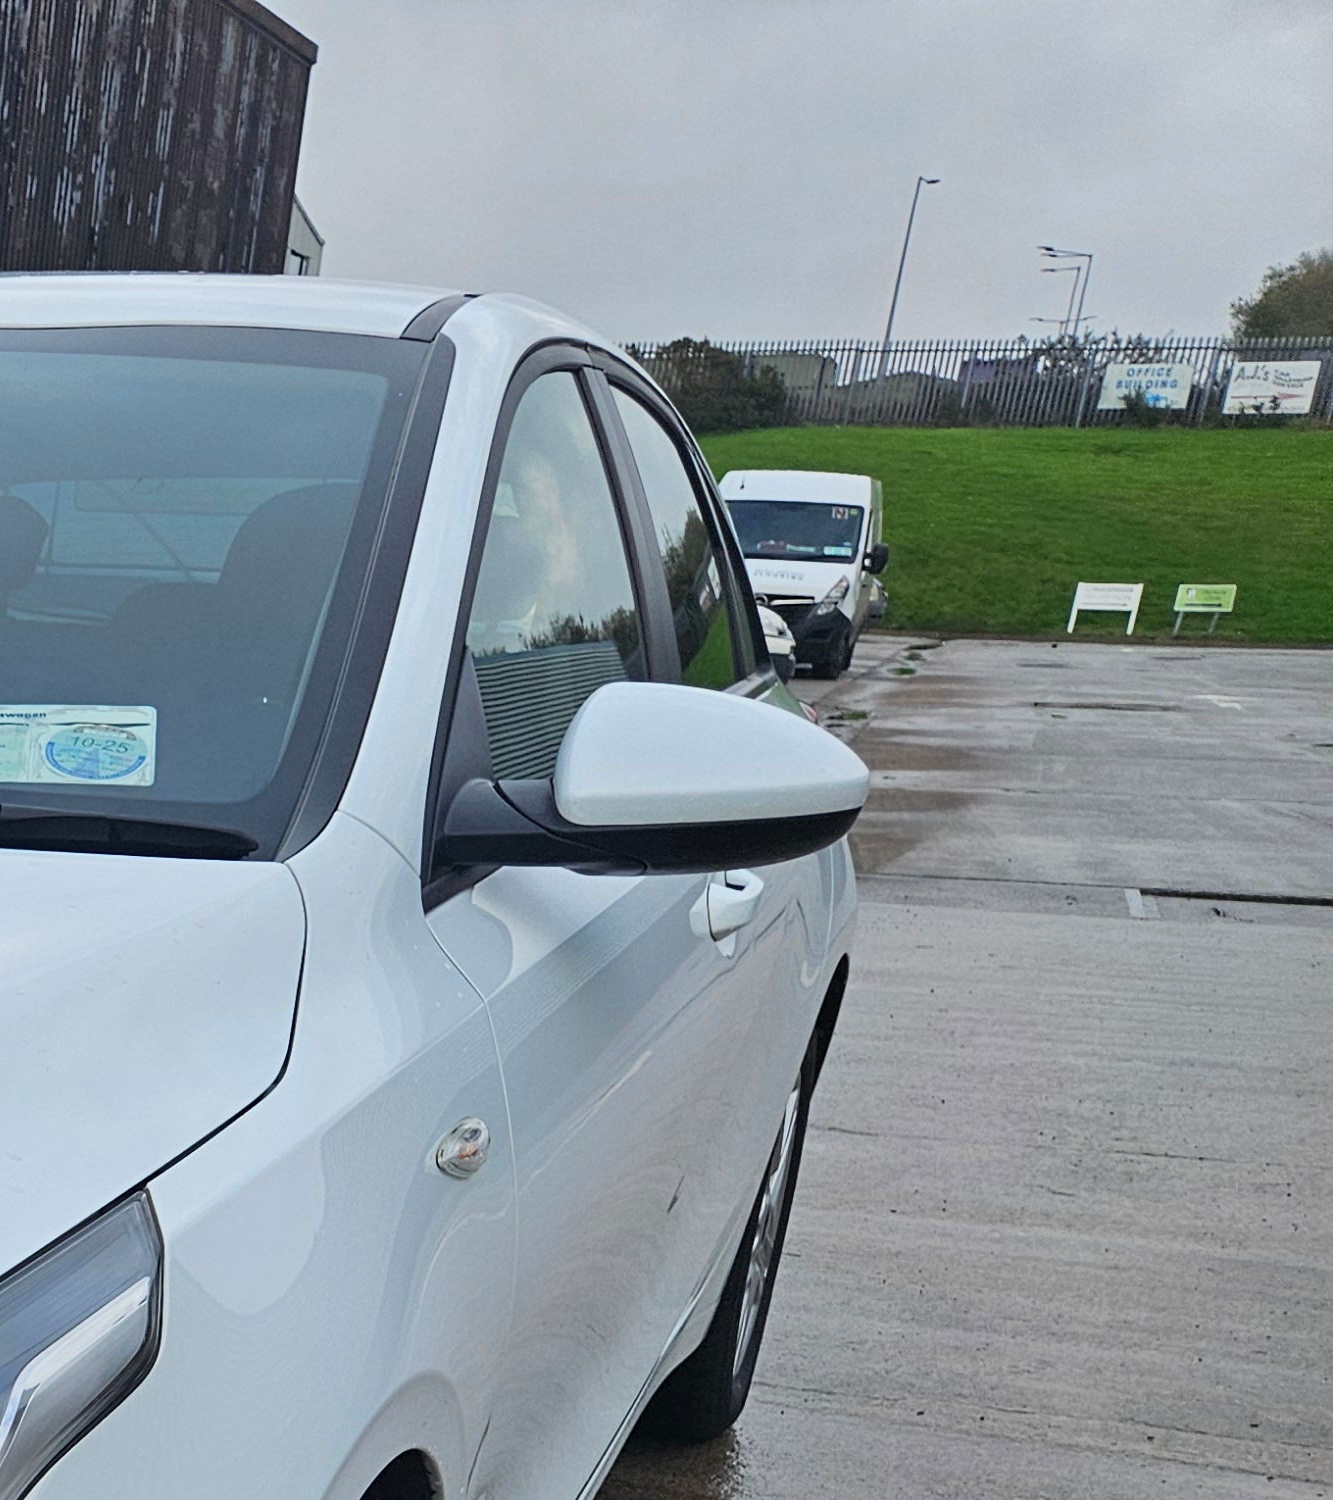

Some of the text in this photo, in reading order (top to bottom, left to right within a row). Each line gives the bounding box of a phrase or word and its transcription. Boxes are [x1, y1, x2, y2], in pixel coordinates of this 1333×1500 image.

[1126, 366, 1174, 378] OFFICE
[1115, 379, 1179, 390] BUILDING
[70, 736, 131, 755] 10-25
